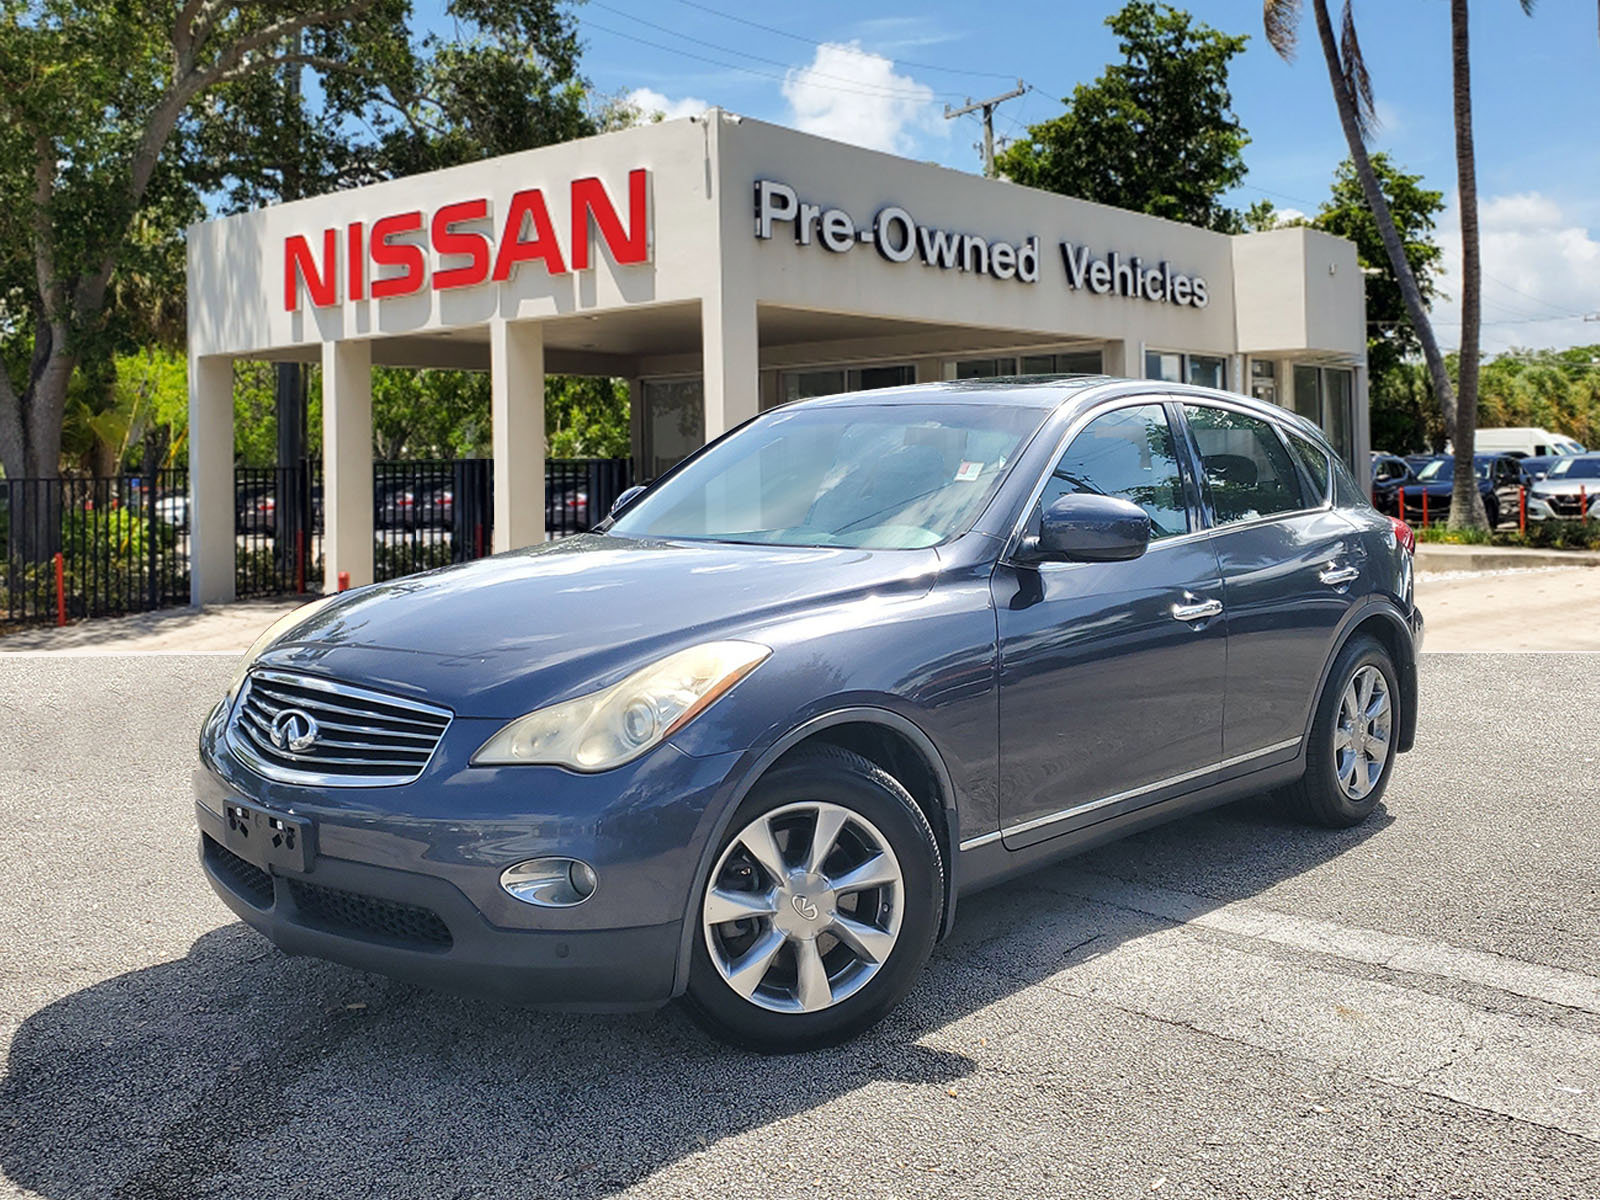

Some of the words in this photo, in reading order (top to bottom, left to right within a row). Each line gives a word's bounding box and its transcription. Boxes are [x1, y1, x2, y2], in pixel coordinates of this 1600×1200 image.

[284, 168, 648, 312] NISSAN
[754, 179, 1040, 284] Pre-Owned
[1060, 241, 1209, 308] Vehicles
